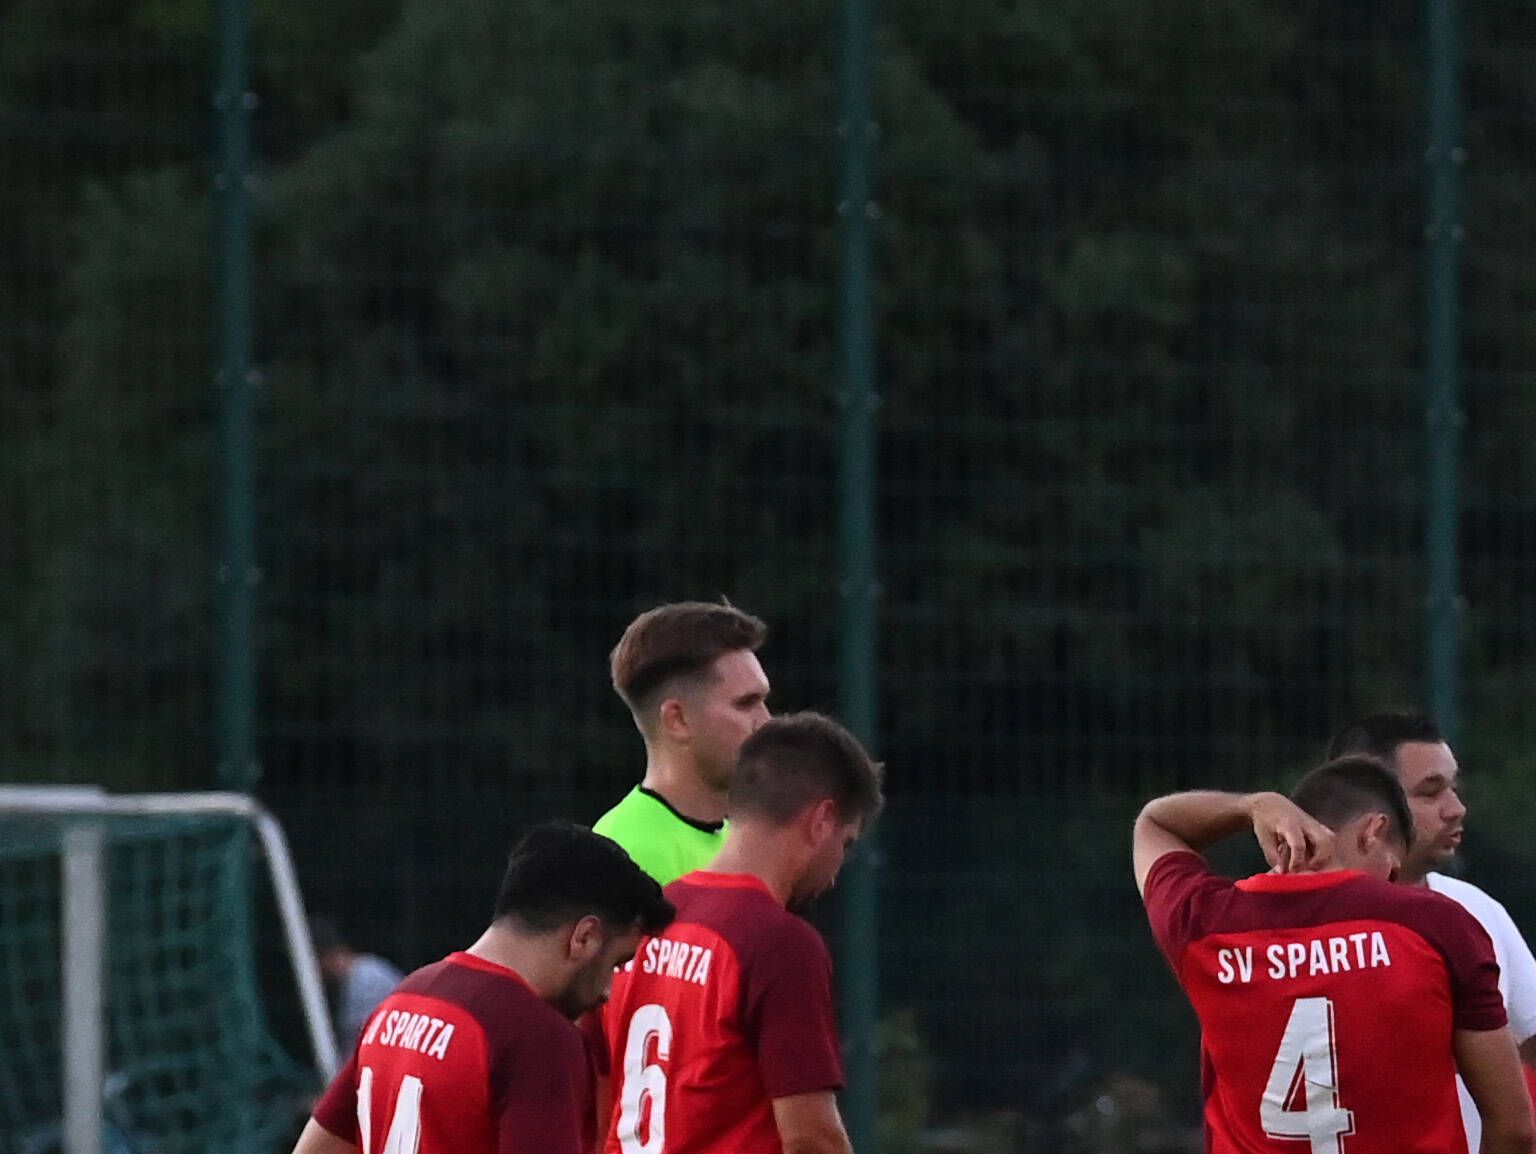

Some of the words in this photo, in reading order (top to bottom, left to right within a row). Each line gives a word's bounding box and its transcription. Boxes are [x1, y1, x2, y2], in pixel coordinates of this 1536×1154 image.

[643, 937, 713, 986] SPARTA
[1217, 946, 1253, 984] SV
[1266, 931, 1391, 980] SPARTA
[379, 1010, 456, 1061] SPARTA
